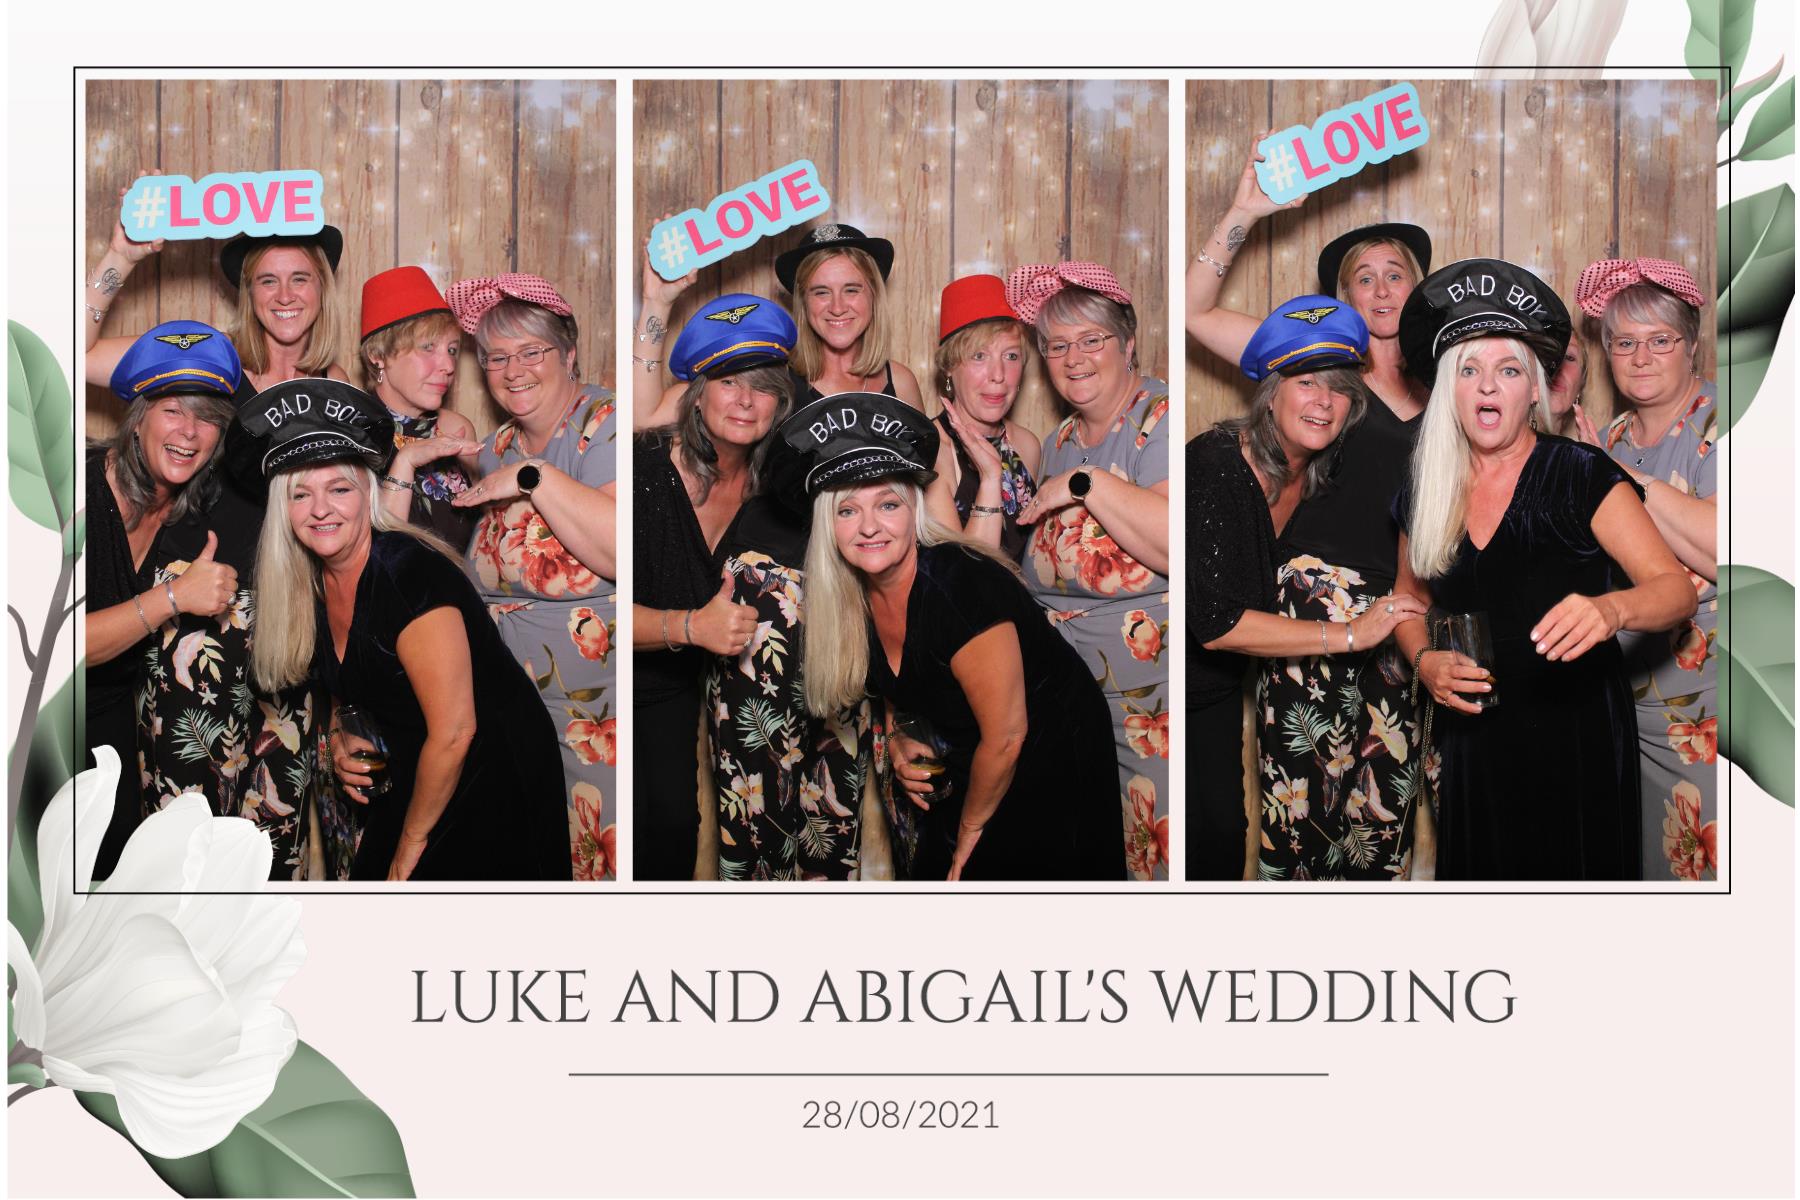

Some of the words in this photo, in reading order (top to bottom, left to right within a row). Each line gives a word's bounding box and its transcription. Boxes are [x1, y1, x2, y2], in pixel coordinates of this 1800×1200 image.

[1266, 92, 1422, 193] #LOVE
[131, 179, 315, 230] #LOVE
[656, 167, 821, 269] #LOVE
[1447, 274, 1496, 303] BAD
[1506, 284, 1548, 317] BOY
[264, 394, 312, 428] BAD
[324, 398, 368, 425] BOY
[808, 408, 858, 444] BAD
[870, 413, 914, 439] BOY
